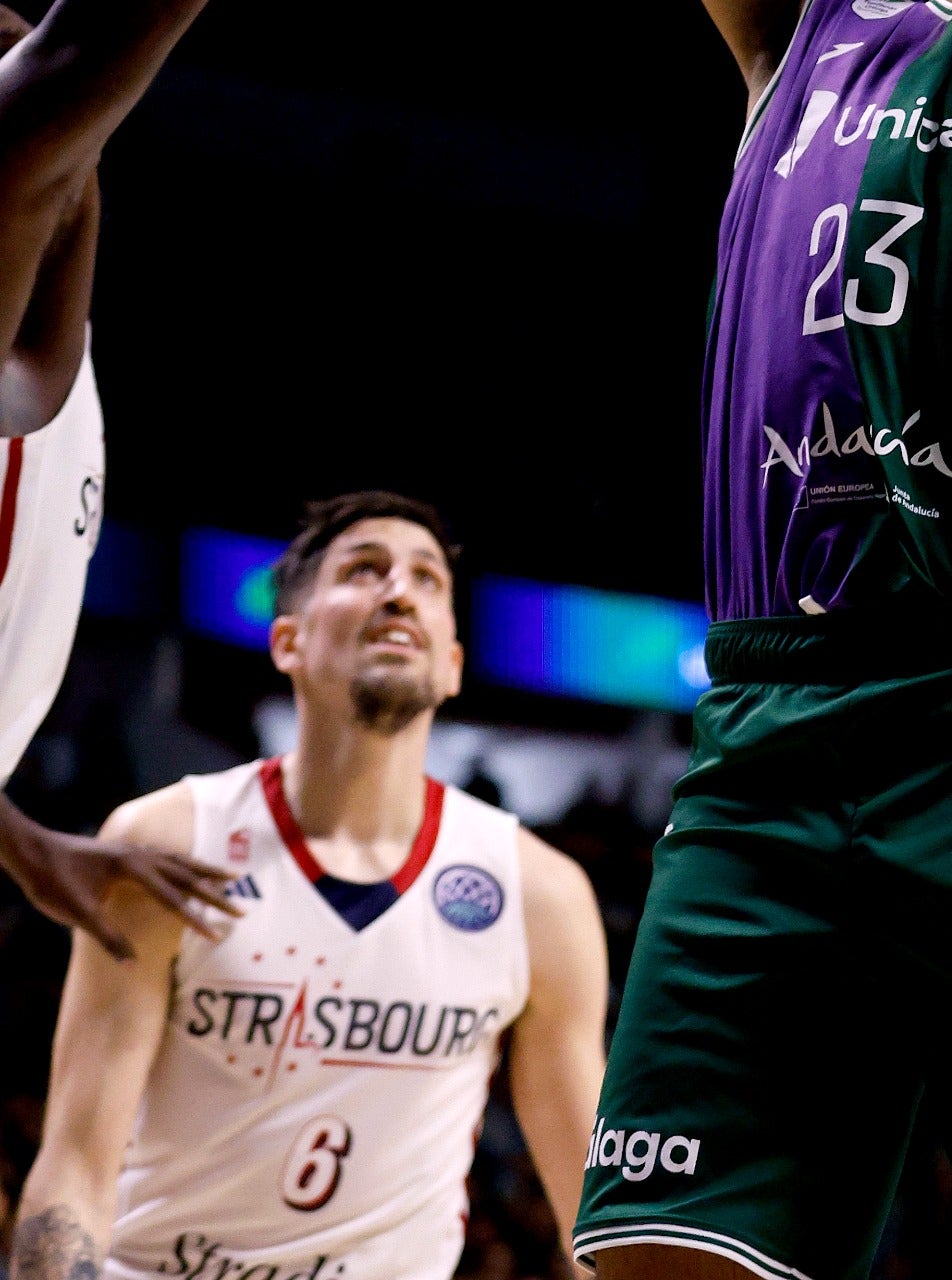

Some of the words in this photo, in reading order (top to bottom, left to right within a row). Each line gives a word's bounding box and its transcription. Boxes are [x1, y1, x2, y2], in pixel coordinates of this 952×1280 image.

[801, 198, 926, 337] 23
[891, 493, 903, 504] de
[902, 498, 940, 519] Andalucía
[892, 484, 911, 501] Junta
[281, 1113, 355, 1213] 6
